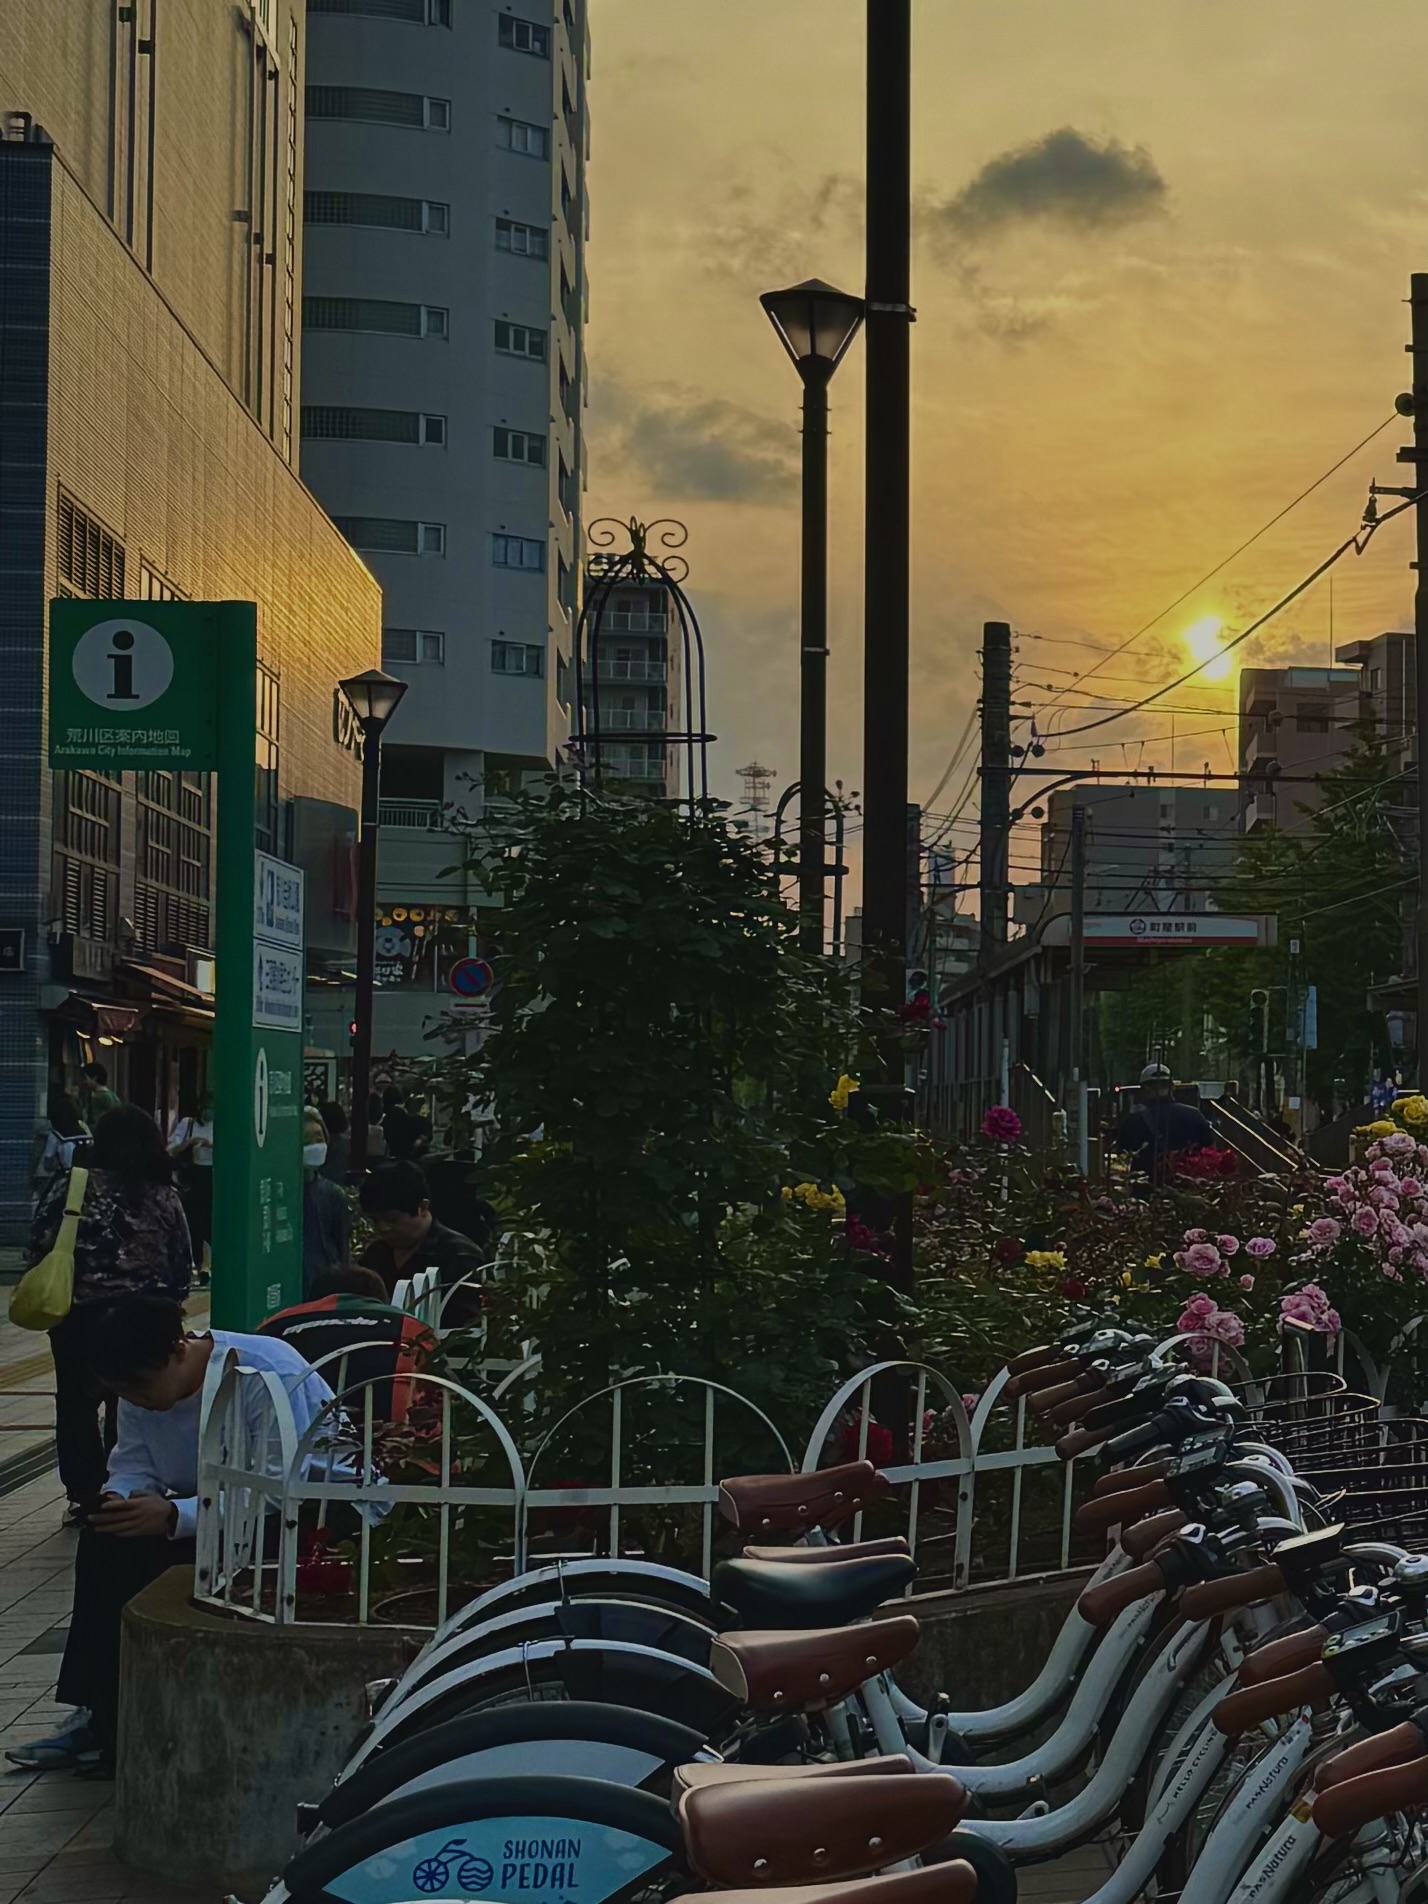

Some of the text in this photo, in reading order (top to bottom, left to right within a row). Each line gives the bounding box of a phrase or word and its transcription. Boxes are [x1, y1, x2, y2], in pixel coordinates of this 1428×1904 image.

[98, 745, 116, 758] City
[171, 746, 192, 759] Map
[502, 1838, 582, 1860] SHONAN
[500, 1861, 580, 1890] PEDAL
